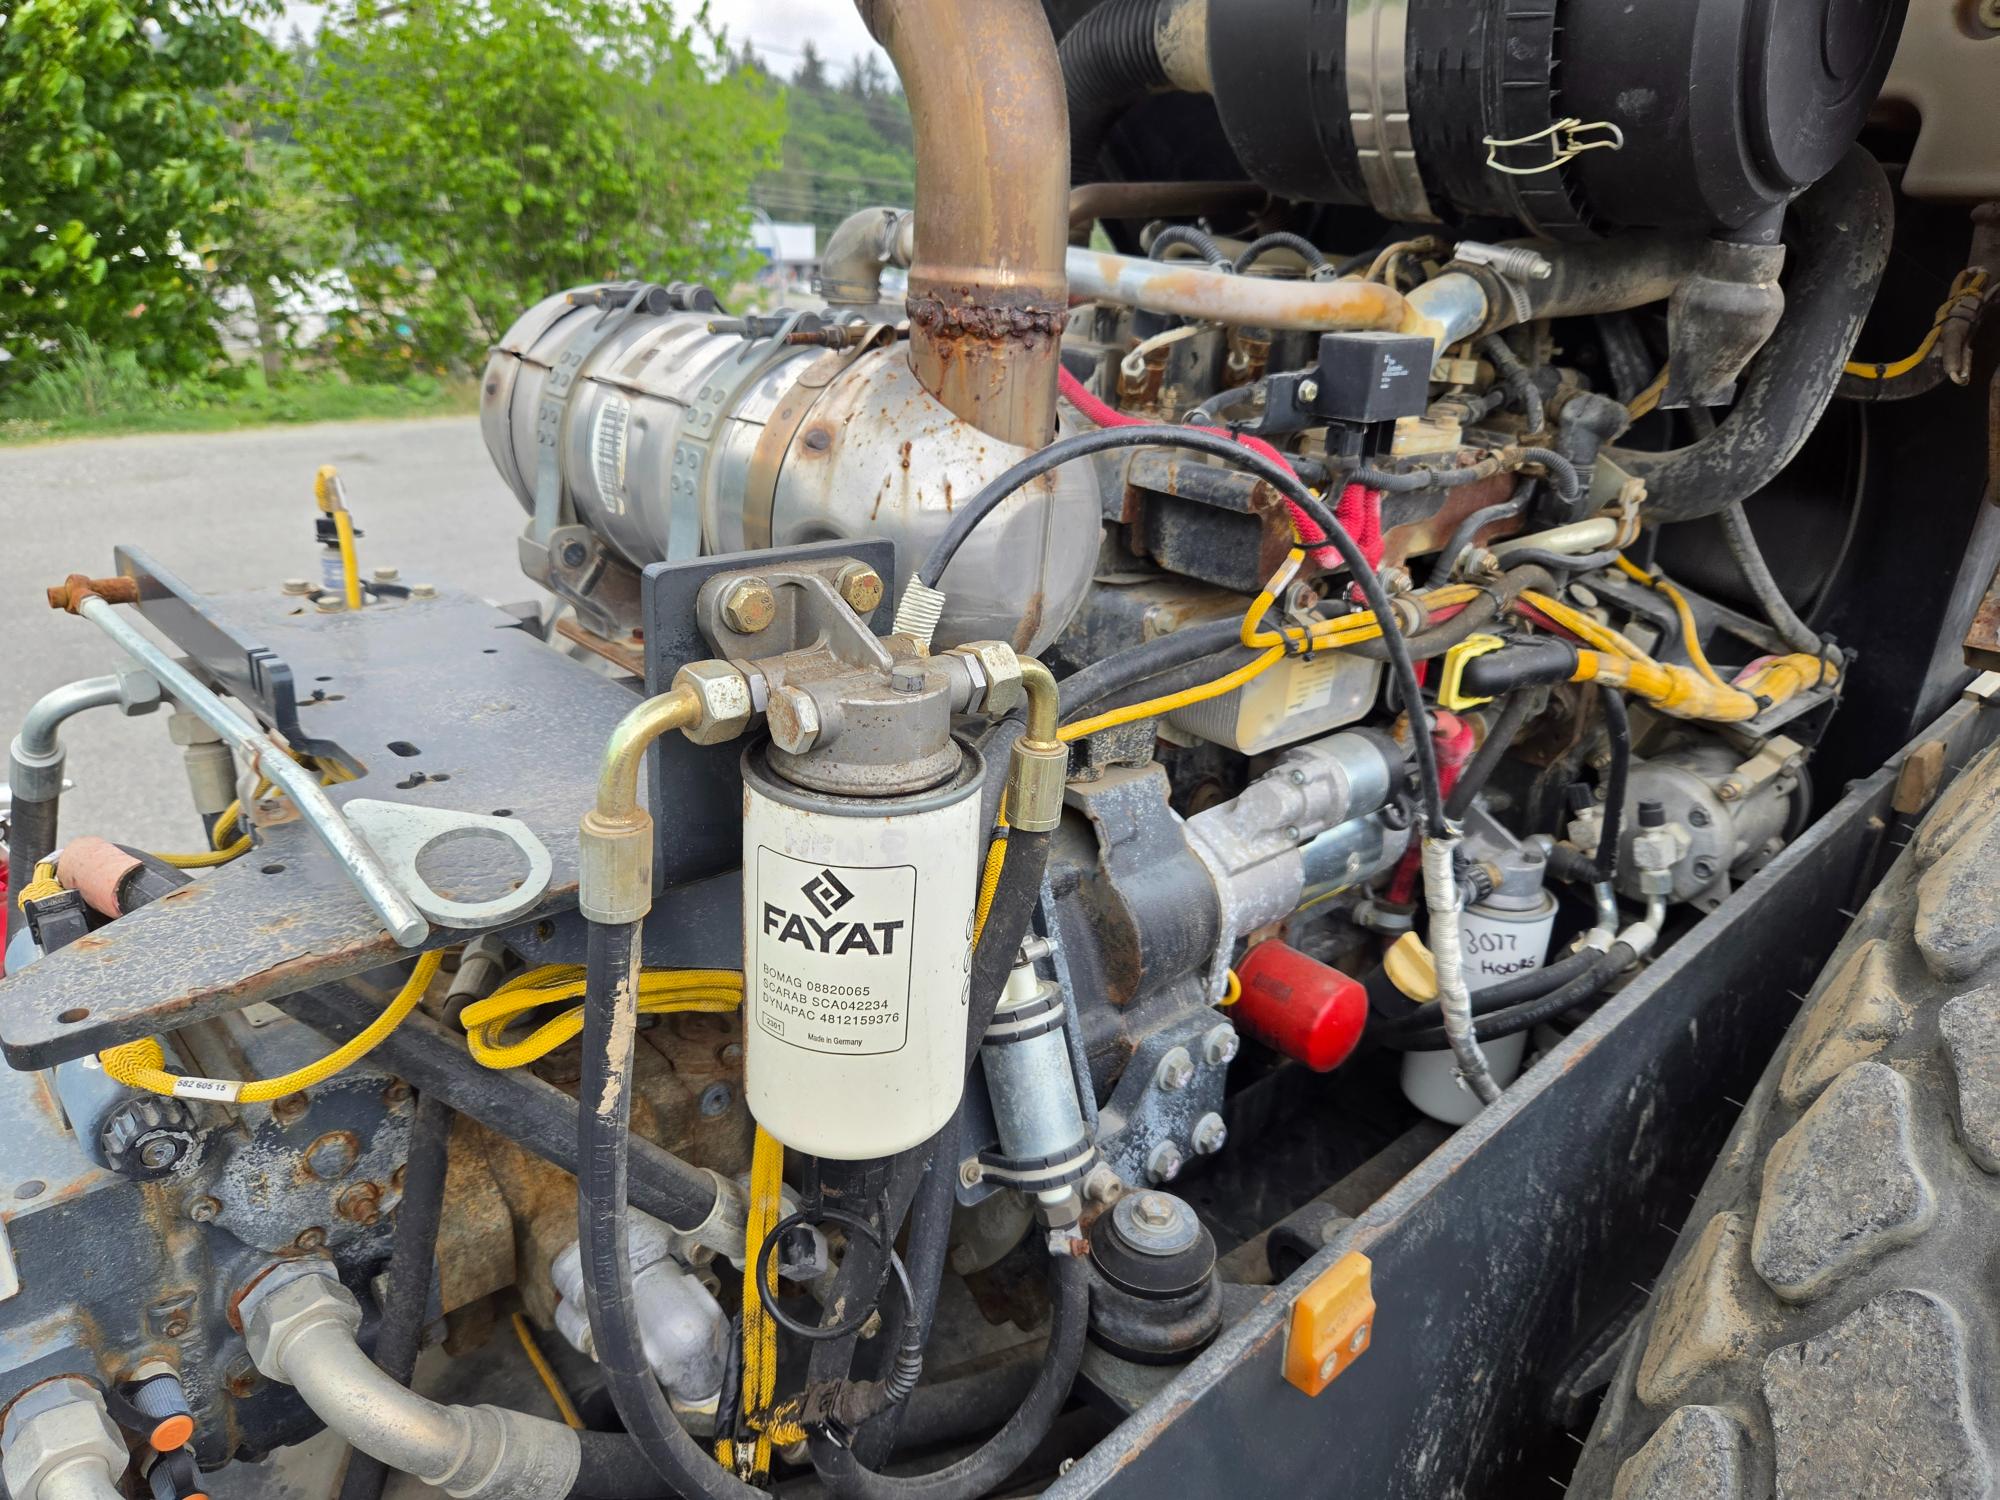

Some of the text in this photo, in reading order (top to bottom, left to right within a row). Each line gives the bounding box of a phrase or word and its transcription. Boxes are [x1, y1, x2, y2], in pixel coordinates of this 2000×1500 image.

[763, 901, 904, 956] FAYAT
[1464, 929, 1518, 955] 3077
[763, 963, 870, 996] BOMAG 08820065
[762, 992, 900, 1025] DYNAPAC 4812159376
[763, 978, 889, 1011] SCARAB SCA042234
[766, 1017, 782, 1031] 2301
[807, 1033, 863, 1047] Made in Germany
[196, 1081, 213, 1089] 605
